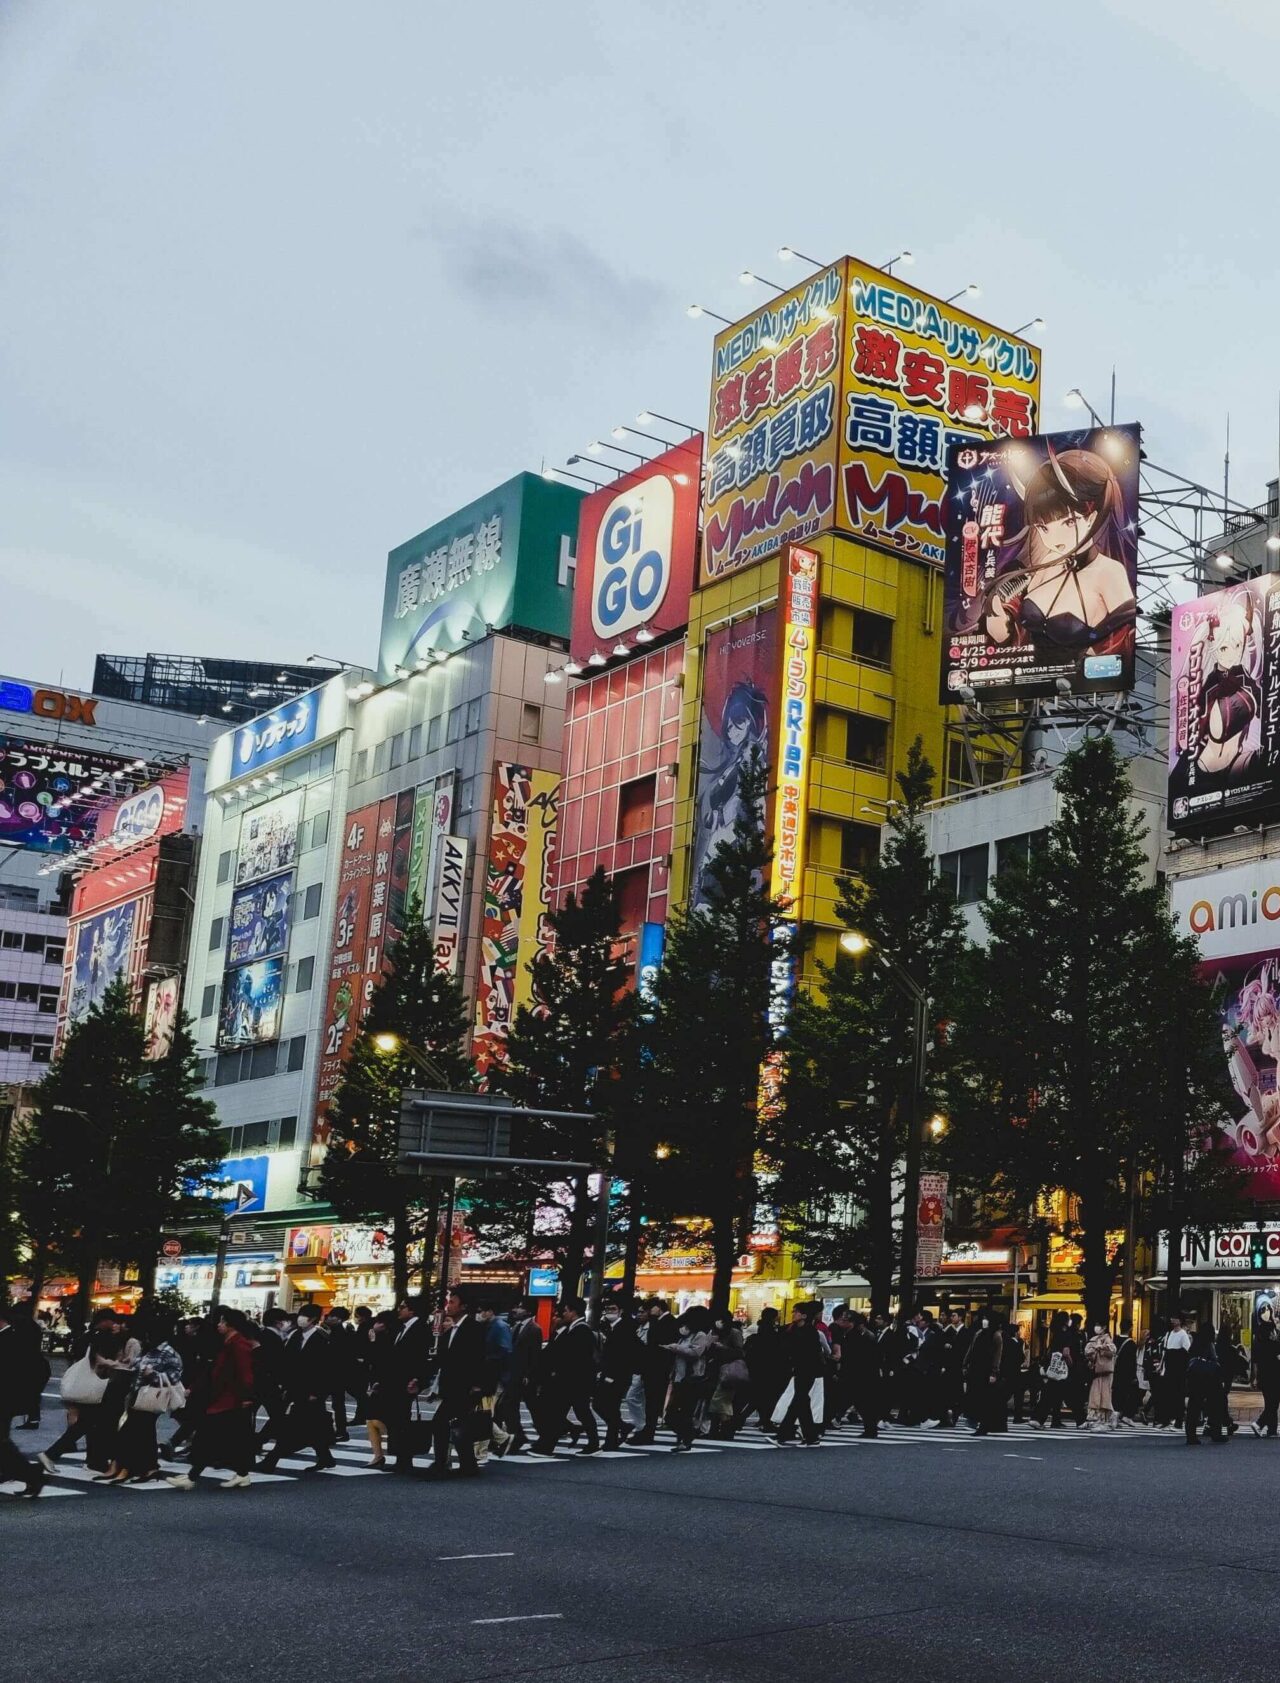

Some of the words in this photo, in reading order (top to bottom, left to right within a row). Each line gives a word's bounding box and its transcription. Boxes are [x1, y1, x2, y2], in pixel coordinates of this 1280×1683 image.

[852, 277, 1036, 382] MEDIAリサイクル
[714, 315, 840, 437] 激安販売
[852, 324, 1033, 440] 激安販売
[708, 381, 834, 505] 高額買取
[706, 462, 834, 575] Mulan
[980, 503, 1006, 550] 能代
[597, 550, 664, 627] GO
[960, 646, 986, 658] 4/25
[346, 823, 365, 851] 4F
[370, 851, 389, 940] 秋葉原
[441, 840, 464, 910] AKKY
[336, 919, 354, 949] 3F
[434, 932, 457, 971] Tax
[325, 1024, 343, 1055] 2F
[1214, 1258, 1251, 1268] Akihab
[1216, 1234, 1280, 1256] COMC
